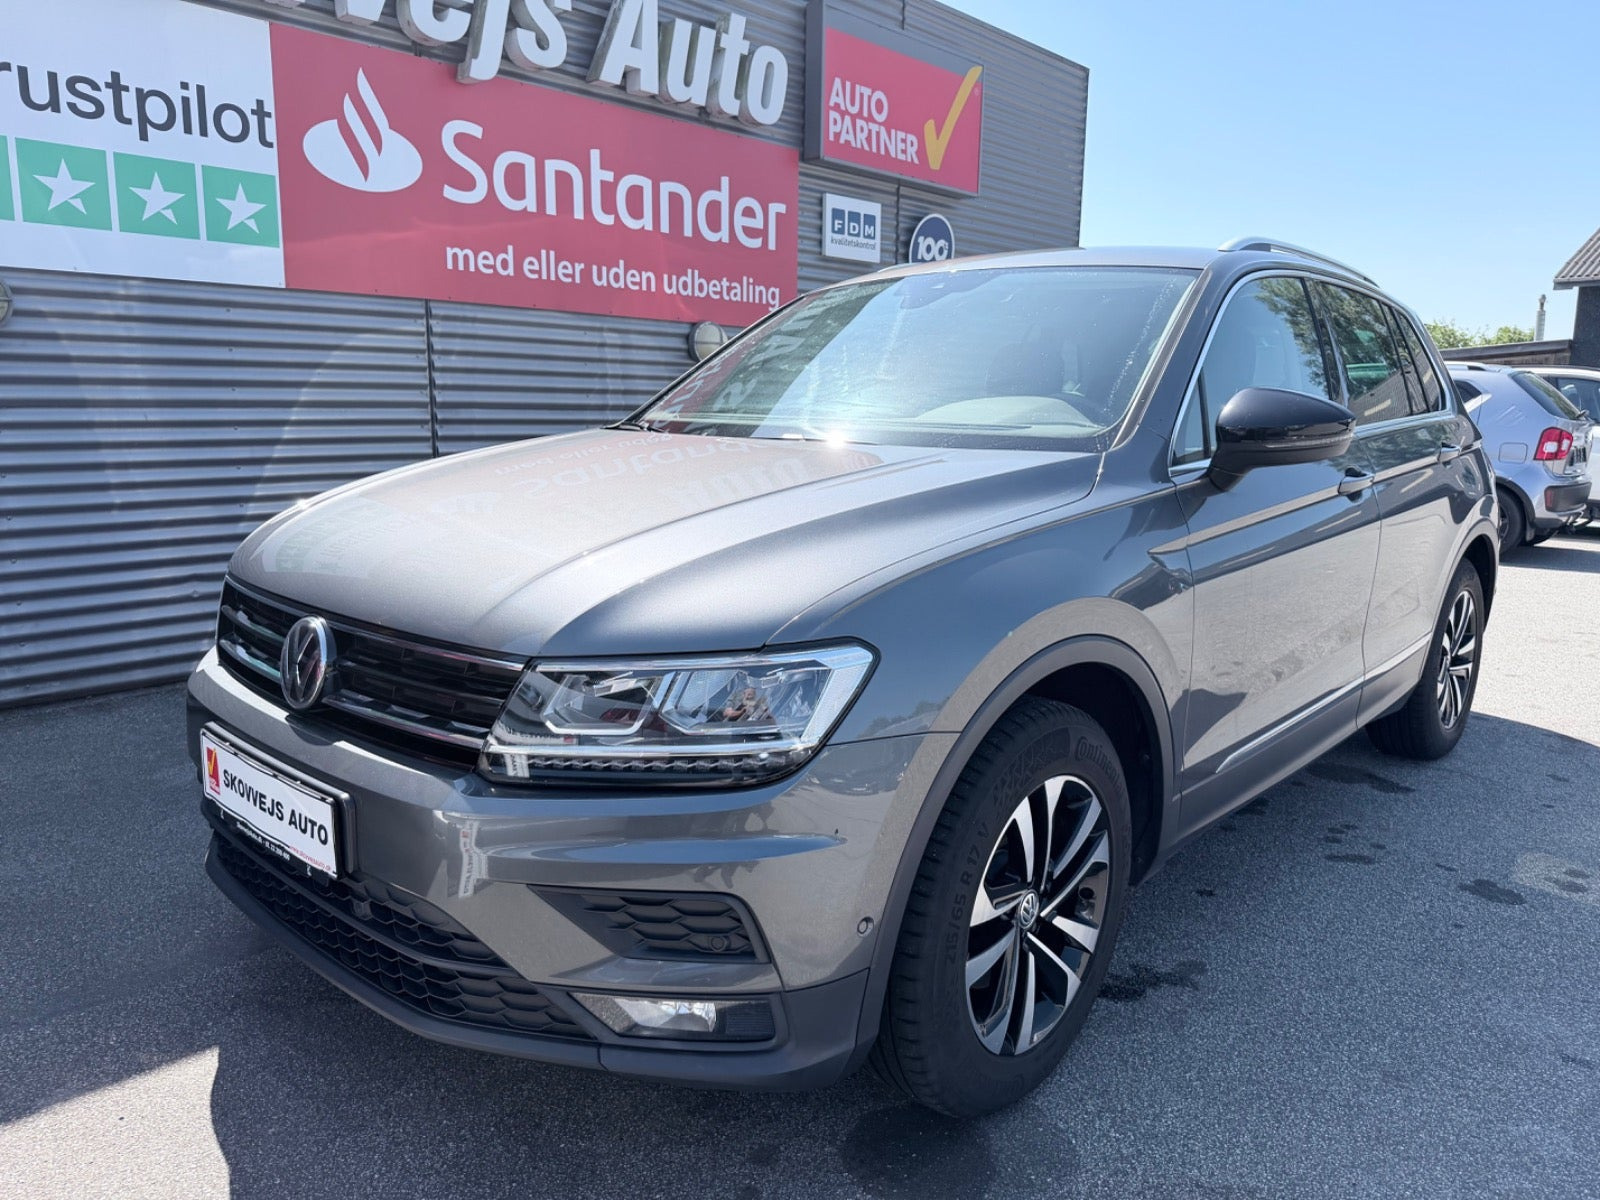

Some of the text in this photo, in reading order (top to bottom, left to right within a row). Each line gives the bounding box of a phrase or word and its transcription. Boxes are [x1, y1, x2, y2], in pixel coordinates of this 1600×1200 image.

[596, 0, 789, 126] Auto
[829, 77, 889, 123] AUTO
[828, 110, 919, 165] PARTNER
[441, 119, 787, 251] Santander
[833, 219, 875, 238] FDM
[446, 246, 780, 310] med eller uden udbetaling
[223, 769, 285, 822] SKOVVEJS
[288, 808, 328, 846] AUTO
